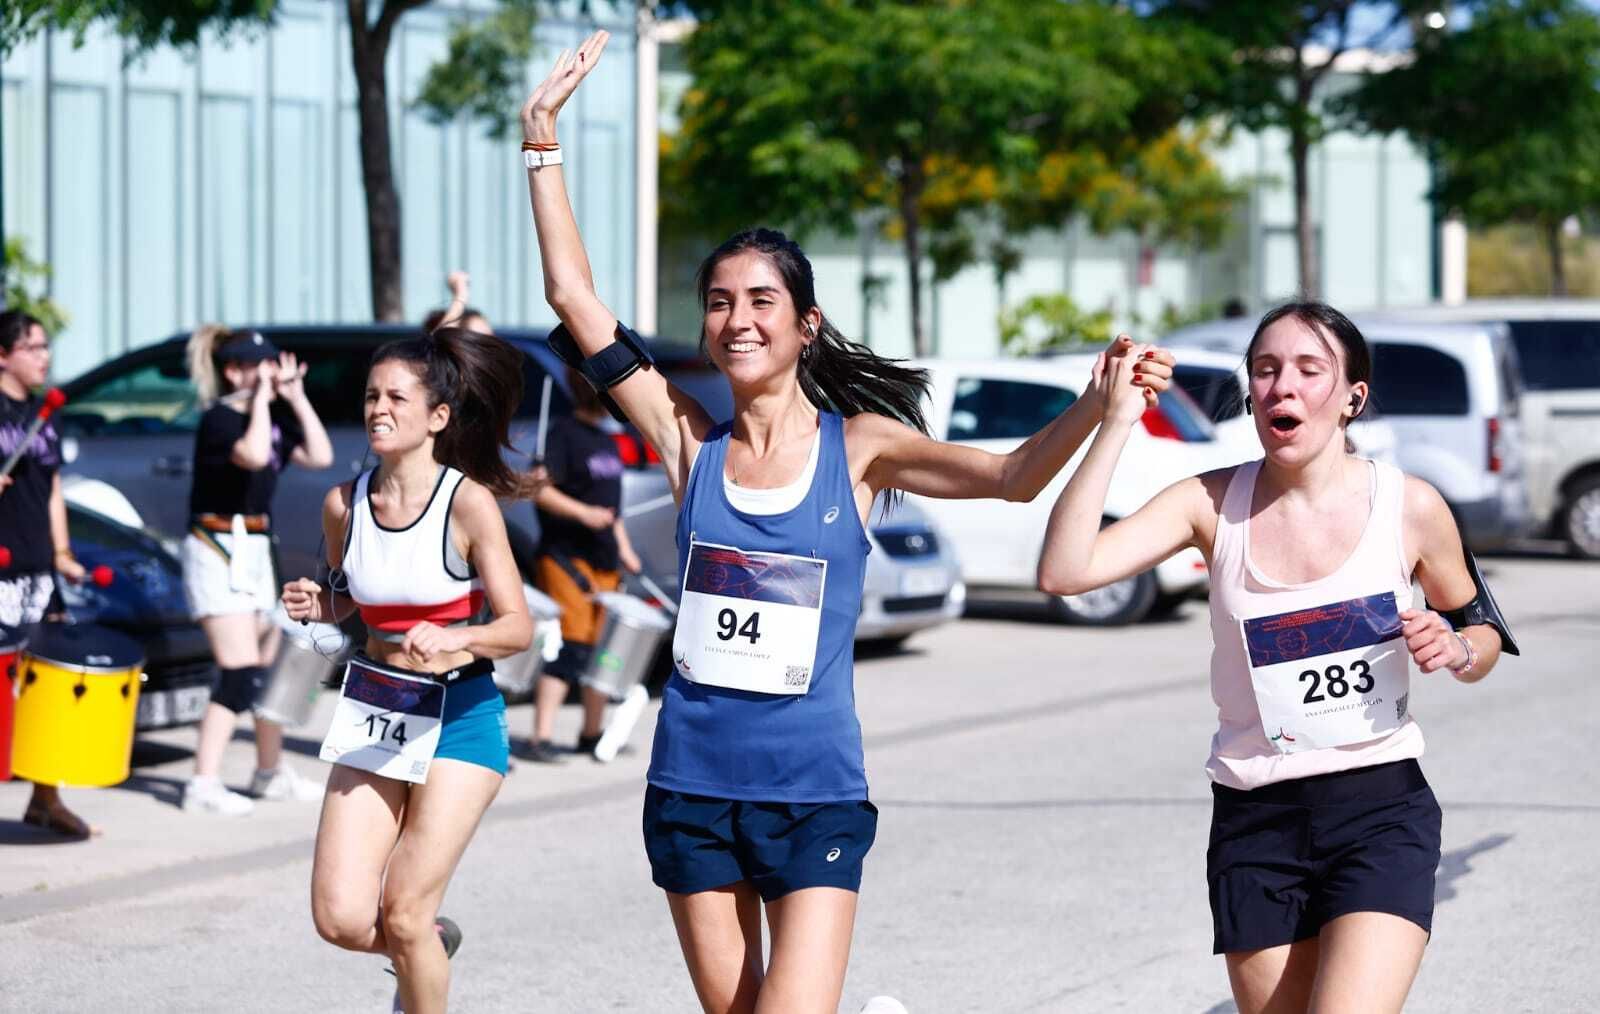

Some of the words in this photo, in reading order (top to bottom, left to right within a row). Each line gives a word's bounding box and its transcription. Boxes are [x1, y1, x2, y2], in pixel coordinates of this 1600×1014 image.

[716, 608, 761, 645] 94
[1298, 659, 1375, 704] 283
[365, 713, 408, 746] 174
